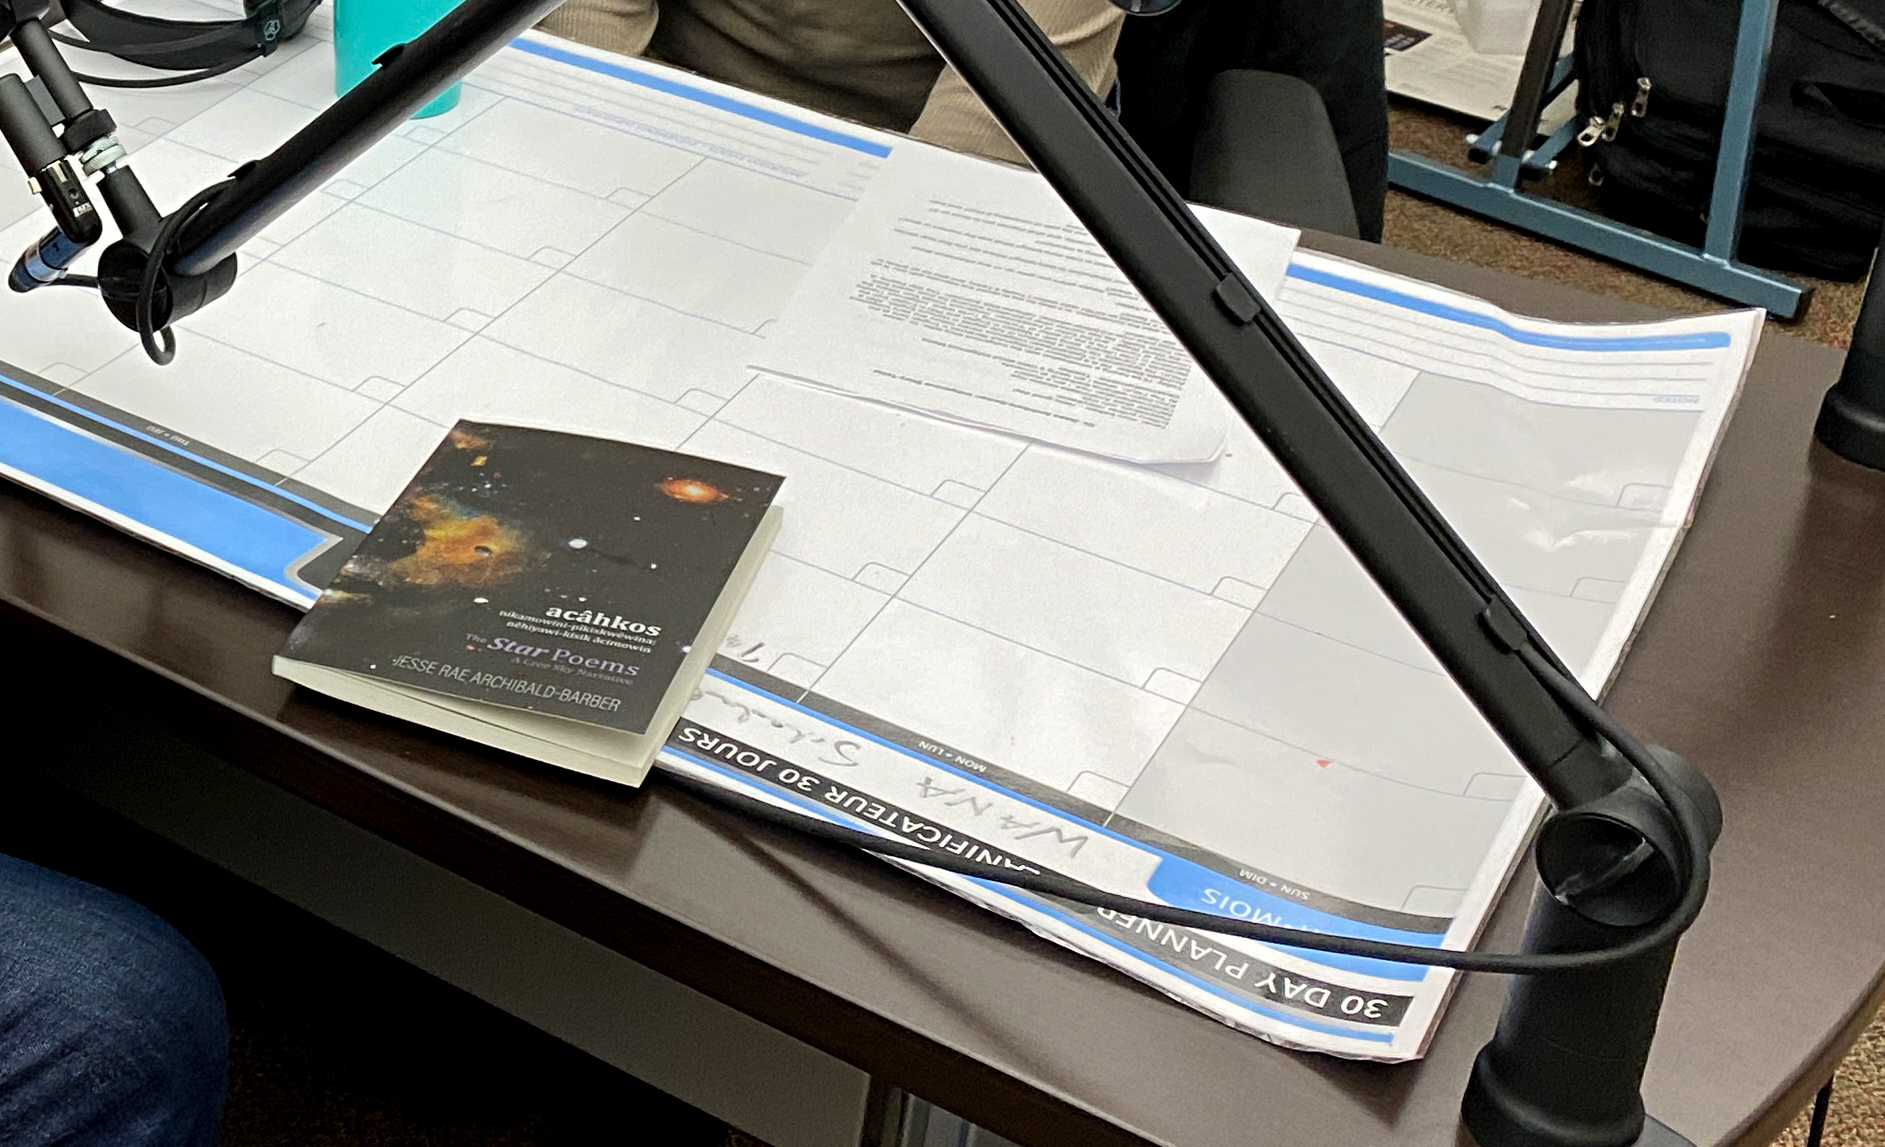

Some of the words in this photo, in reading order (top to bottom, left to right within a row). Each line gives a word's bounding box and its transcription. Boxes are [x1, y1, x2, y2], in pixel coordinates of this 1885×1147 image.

[545, 606, 662, 637] acâhkos
[486, 637, 550, 657] Star
[551, 648, 641, 676] Poems
[394, 654, 439, 675] JESSE
[438, 664, 470, 682] RAE
[468, 671, 622, 712] ARCHIBALD-BARBER
[678, 727, 776, 773] JOURS
[918, 739, 947, 756] LUN
[954, 755, 987, 773] MON
[778, 768, 820, 792] 30
[1238, 868, 1268, 886] DIM
[1281, 882, 1311, 901] SUN
[1254, 971, 1332, 1008] DAY
[1340, 995, 1389, 1019] 30
